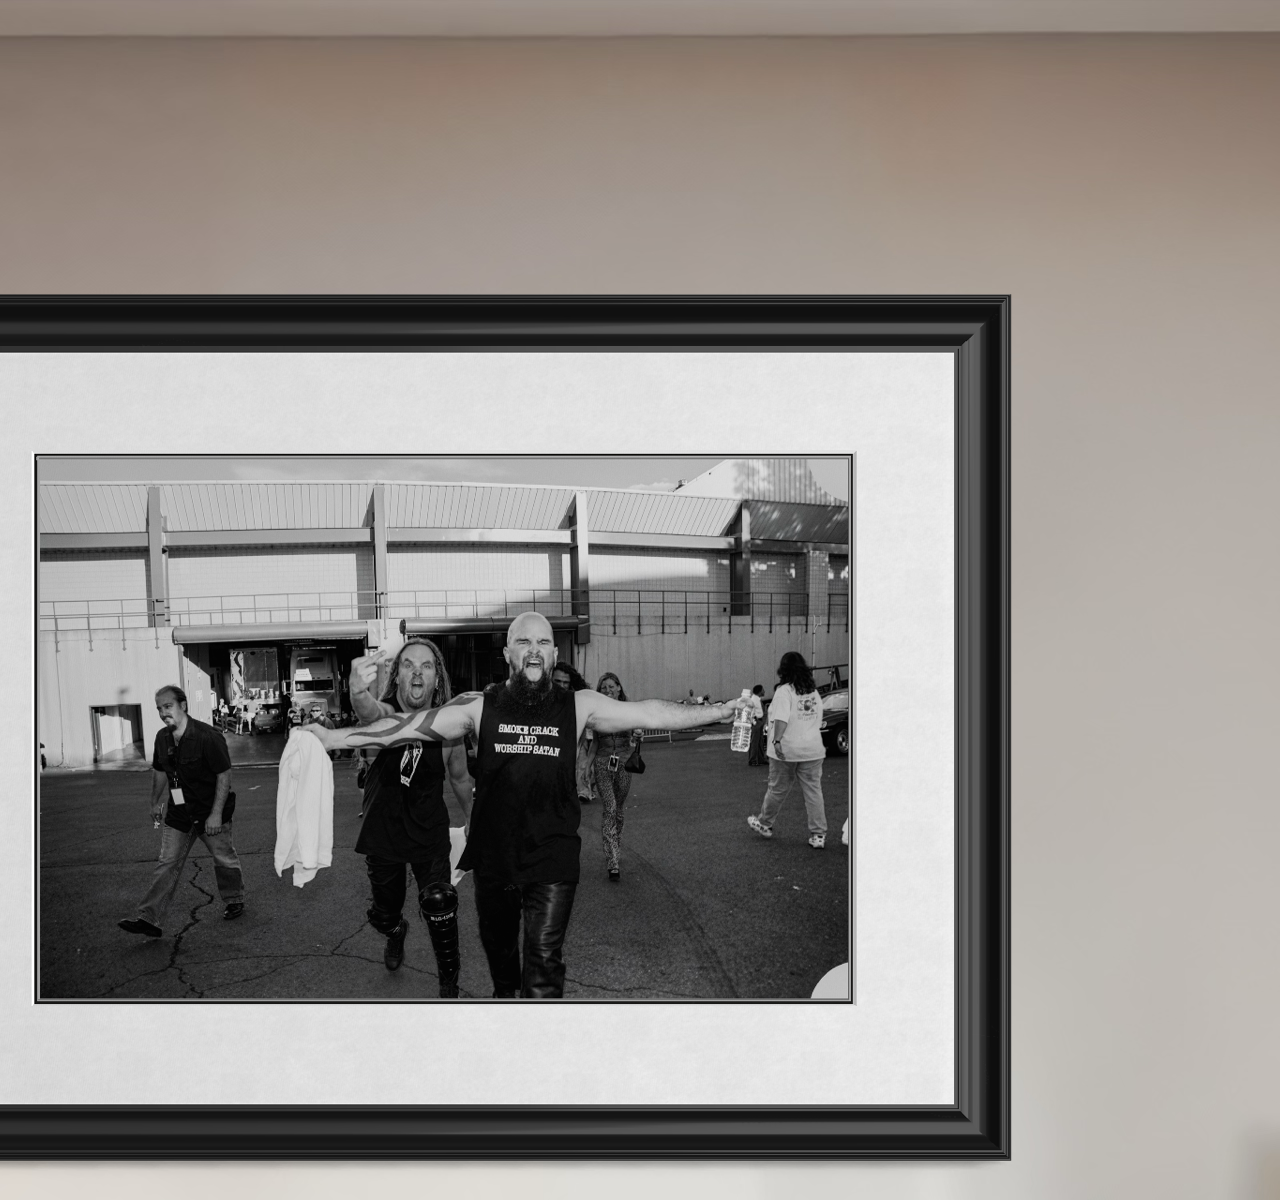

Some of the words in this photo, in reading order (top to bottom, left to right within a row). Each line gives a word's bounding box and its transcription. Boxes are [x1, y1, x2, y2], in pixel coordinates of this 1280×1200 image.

[498, 724, 529, 734] SMOKE
[529, 725, 560, 736] CRACK
[517, 735, 538, 744] AND
[494, 743, 532, 754] WORSHIP
[532, 744, 561, 757] SATAN
